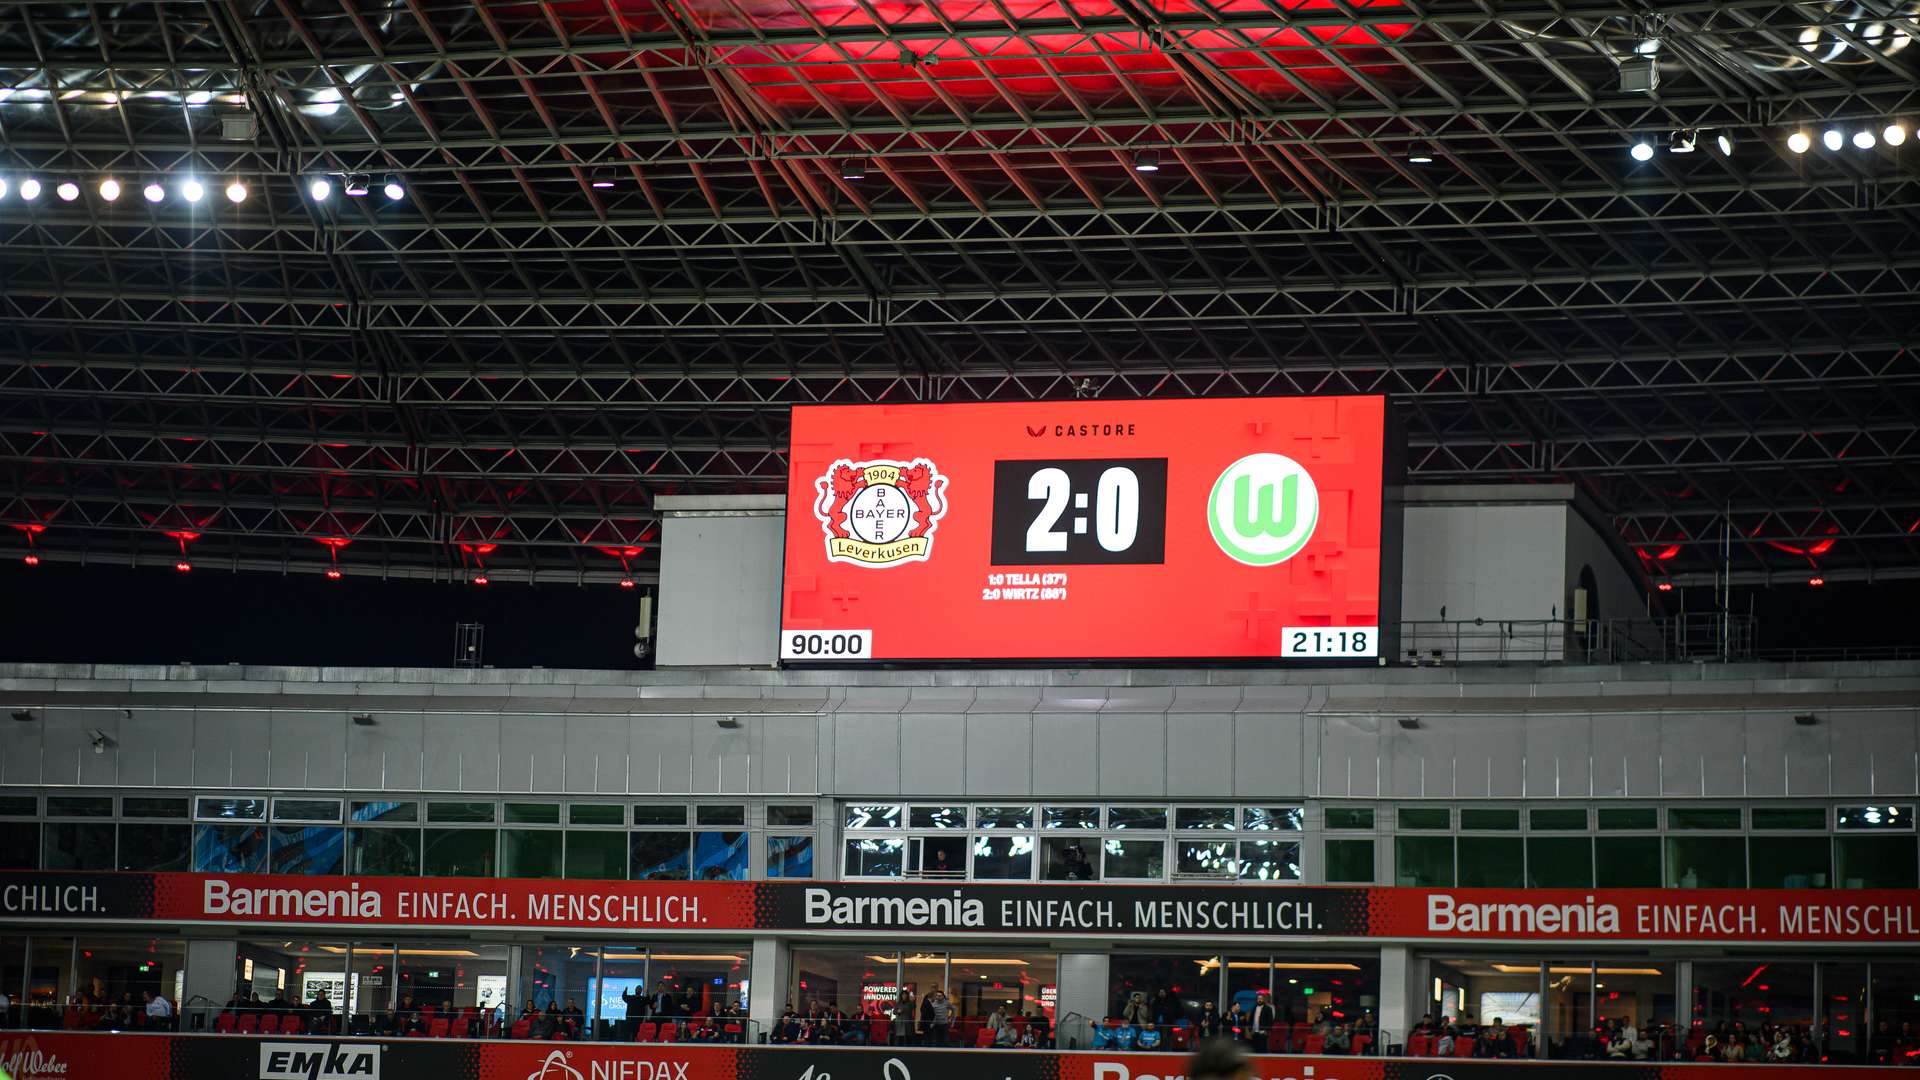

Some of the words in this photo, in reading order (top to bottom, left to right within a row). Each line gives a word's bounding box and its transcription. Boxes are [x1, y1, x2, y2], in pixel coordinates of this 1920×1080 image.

[1055, 423, 1136, 437] CASTORE
[867, 469, 896, 481] 1904
[855, 509, 906, 519] BAYER
[874, 488, 886, 541] BAYER
[1025, 466, 1140, 552] 2:0
[838, 541, 920, 560] Leverkusen
[1005, 573, 1041, 585] TELLA
[982, 588, 1001, 600] 2:0
[1002, 588, 1040, 600] WIRTZ
[791, 634, 863, 655] 90:00
[1292, 631, 1367, 653] 21:18
[3, 884, 106, 913] CHLICH.
[203, 879, 382, 918] Barmenia
[397, 891, 516, 920] EINFACH.
[528, 893, 707, 923] MENSCHLICH.
[805, 887, 985, 927] Barmenia
[1001, 899, 1123, 928] EINFACH.
[1134, 900, 1323, 930] MENSCHLICH.
[1427, 894, 1621, 934] Barmenia
[1637, 904, 1767, 934] EINFACH.
[1779, 904, 1920, 935] MENSCHL
[863, 985, 897, 993] POWERED
[23, 1050, 67, 1074] Weber
[267, 1041, 373, 1080] EMKA
